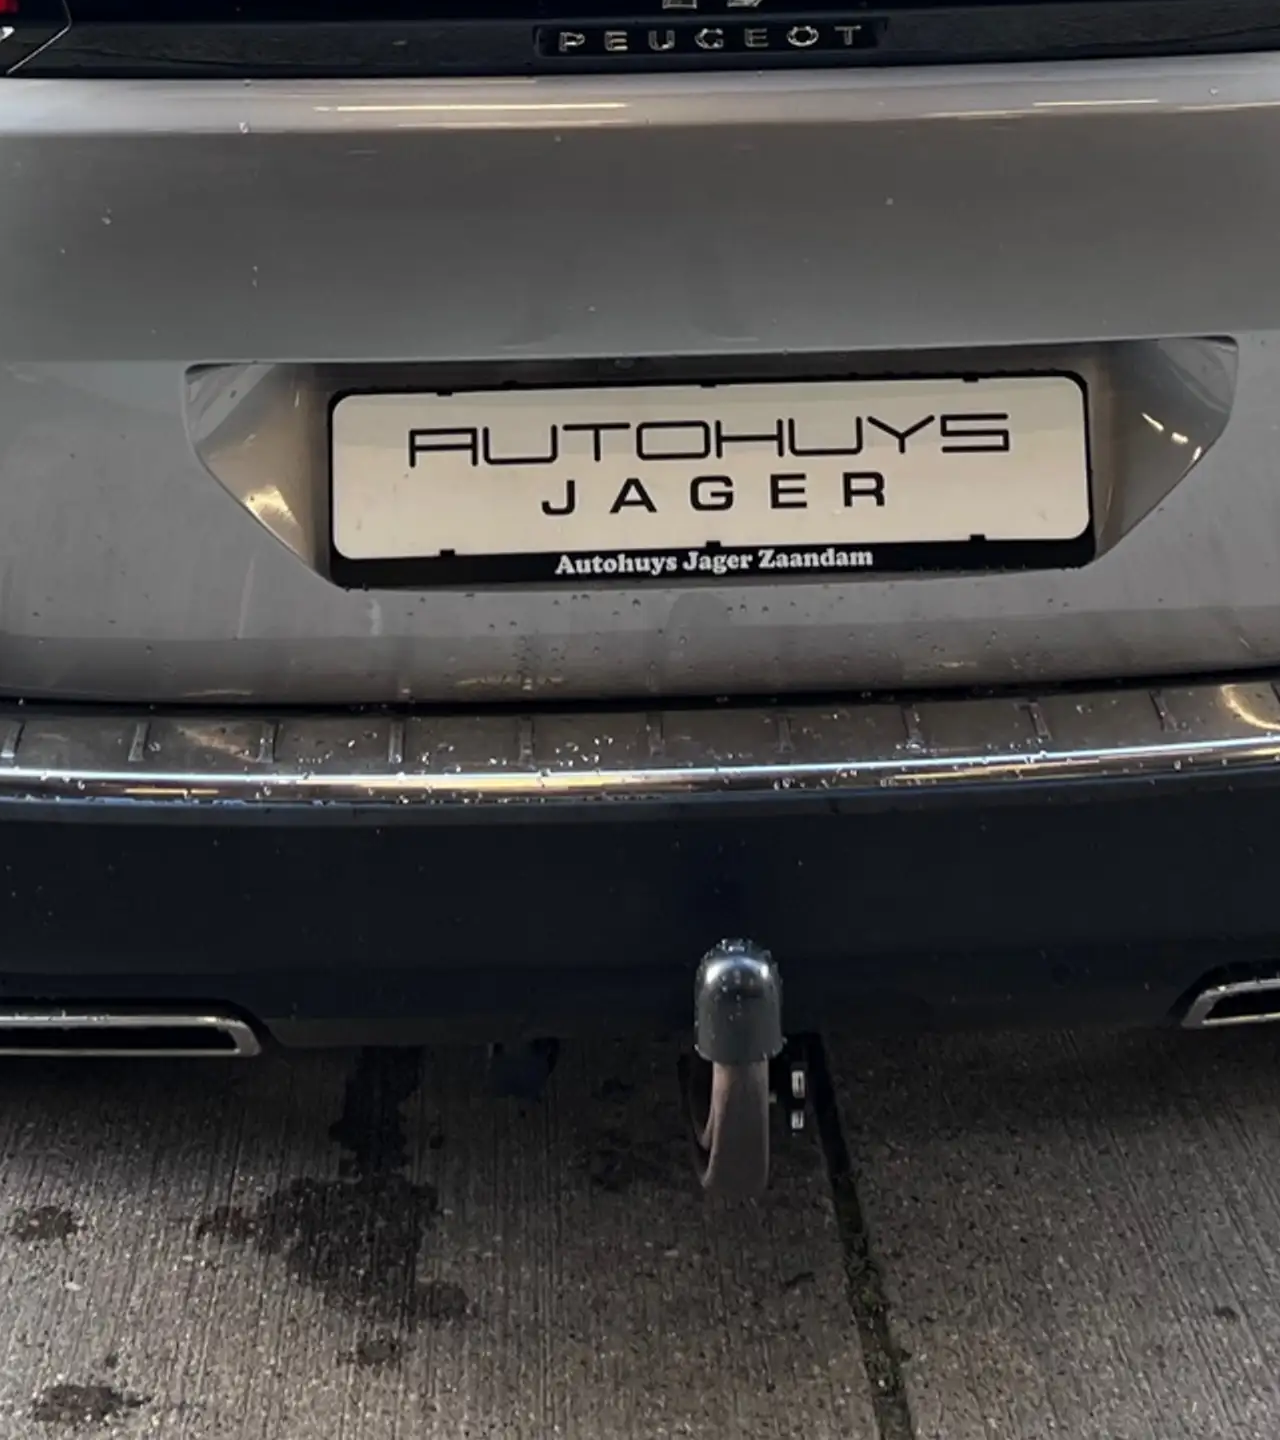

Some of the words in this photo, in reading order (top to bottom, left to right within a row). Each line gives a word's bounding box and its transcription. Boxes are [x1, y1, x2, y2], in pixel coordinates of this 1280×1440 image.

[557, 25, 862, 52] PEUGEOT
[408, 413, 1010, 468] AUTOHUYS
[541, 471, 886, 516] JAGER
[555, 554, 677, 576] Autohuys
[682, 551, 753, 574] Jager
[758, 548, 873, 569] Zaandam
